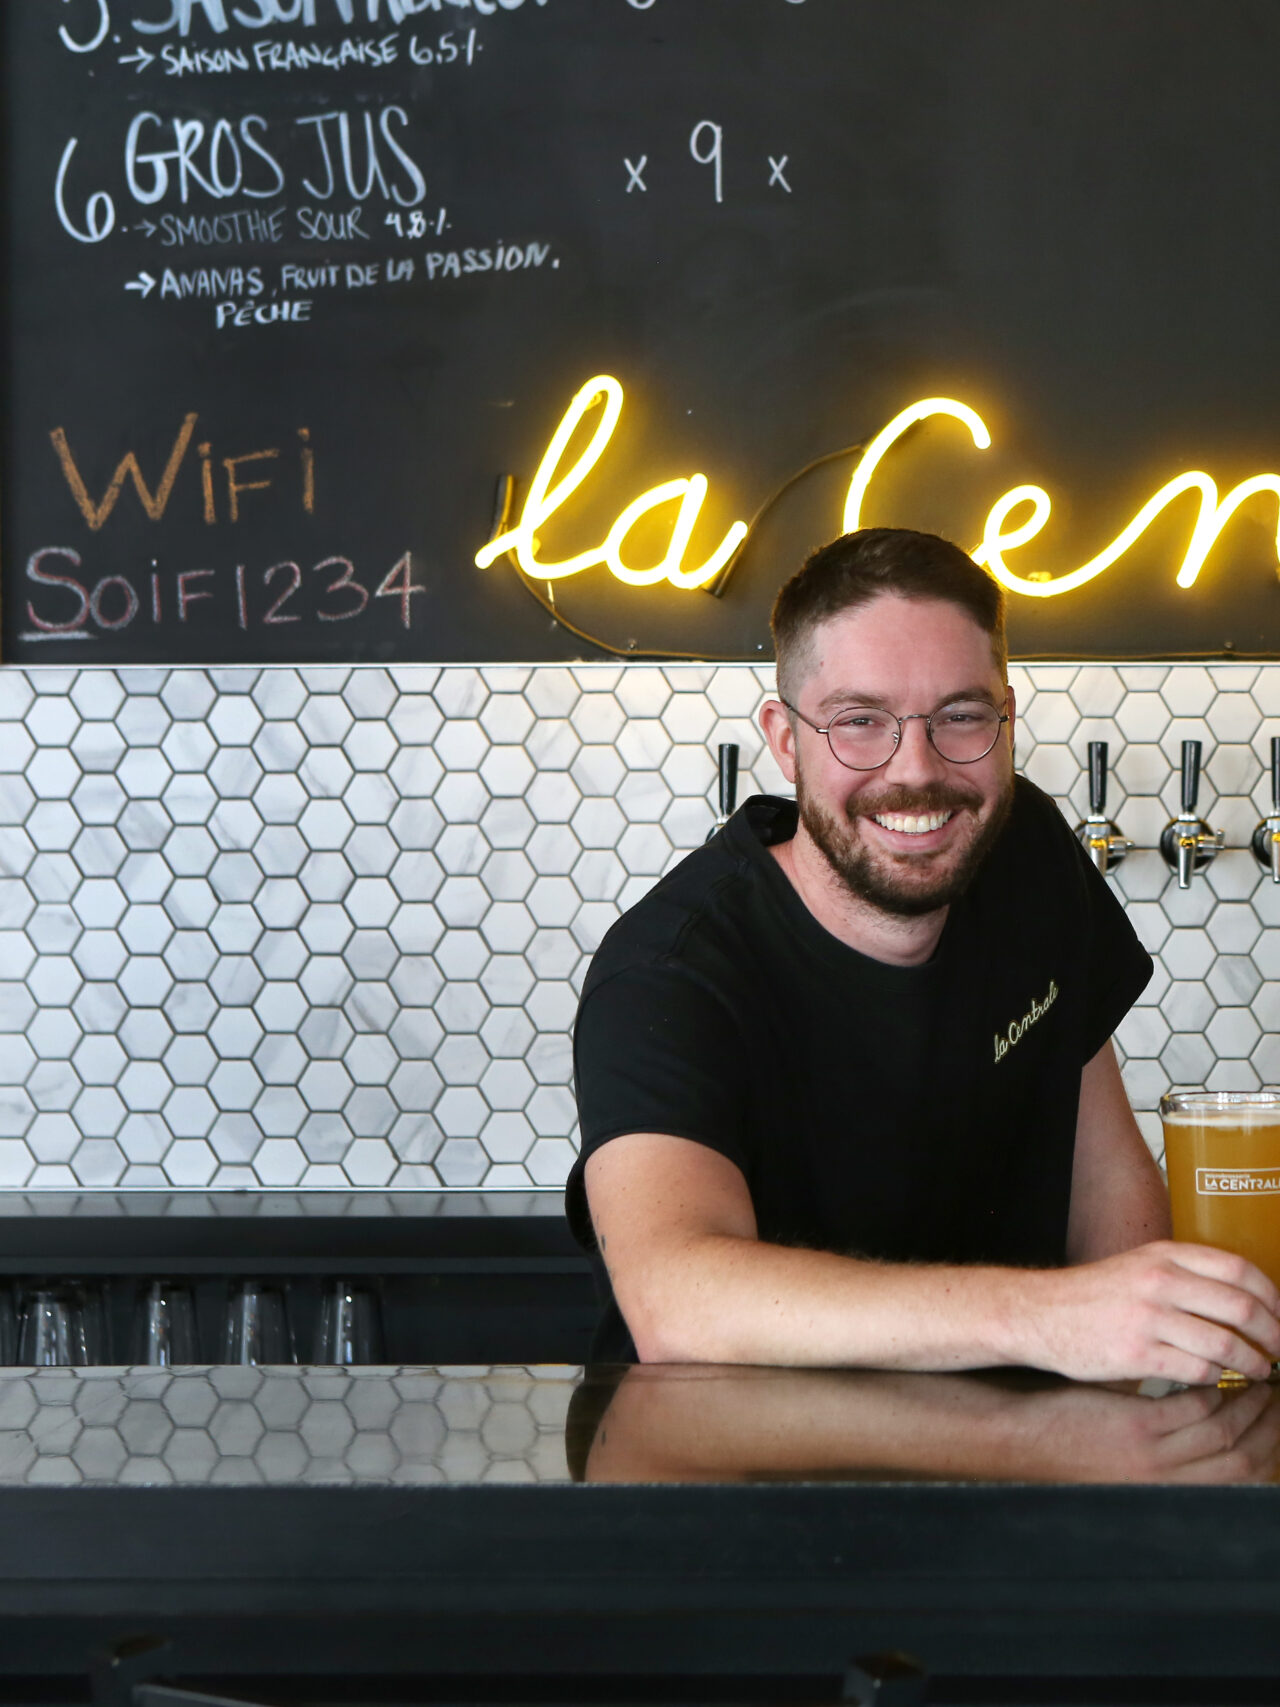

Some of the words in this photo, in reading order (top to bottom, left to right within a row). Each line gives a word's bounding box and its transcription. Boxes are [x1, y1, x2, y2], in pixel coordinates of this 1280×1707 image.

[161, 40, 249, 76] SAISON
[254, 33, 400, 71] FRANÇAISE
[125, 110, 285, 204] GROS
[296, 106, 426, 206] JUS
[690, 119, 723, 203] 9
[160, 206, 287, 246] SMOOTHIE
[296, 208, 371, 241] SOUR
[280, 258, 339, 289] FRUIT
[346, 262, 380, 289] DE
[387, 257, 415, 282] LA
[216, 301, 313, 330] PÊCHE
[1008, 980, 1059, 1045] Centrale
[1205, 1177, 1218, 1190] LA
